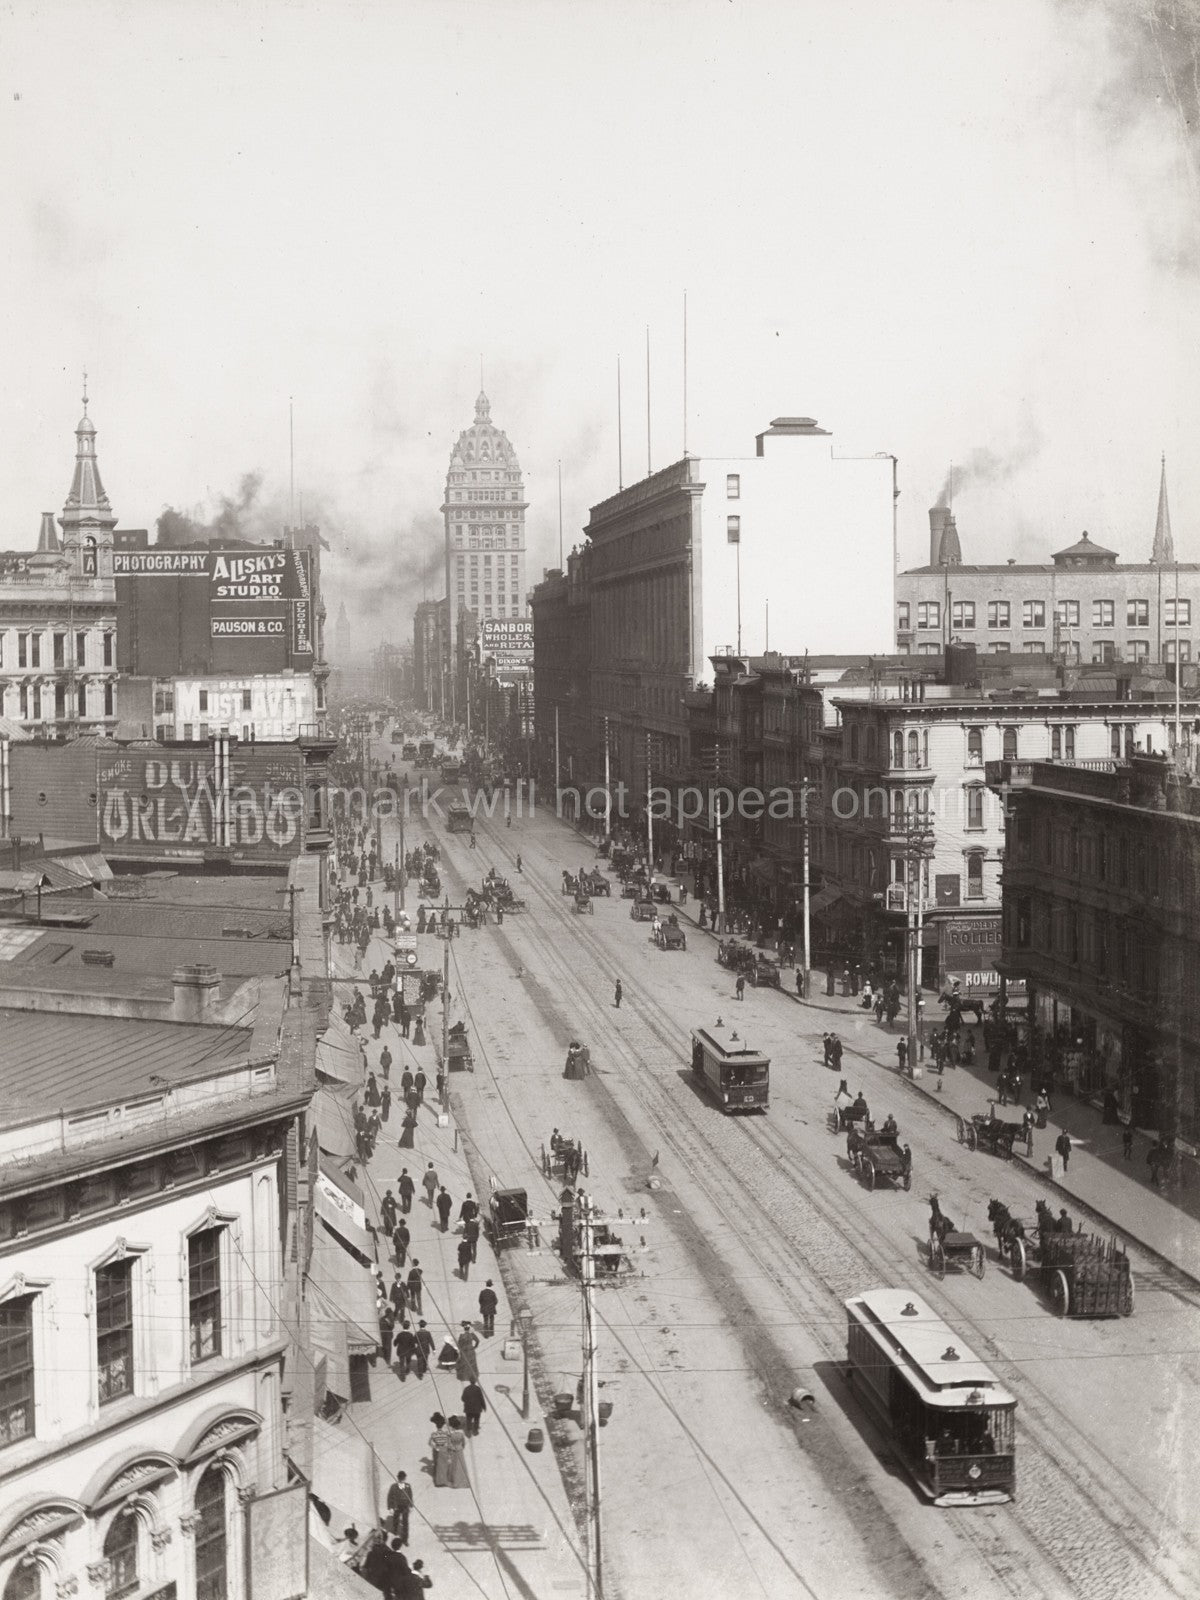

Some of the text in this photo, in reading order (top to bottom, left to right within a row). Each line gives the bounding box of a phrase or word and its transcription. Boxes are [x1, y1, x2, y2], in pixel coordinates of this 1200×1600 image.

[114, 555, 207, 571] PHOTOGRAPHY
[212, 553, 286, 582] ALISKY'S
[249, 574, 284, 584] ART
[217, 585, 283, 596] STUDIO.
[213, 621, 285, 633] PAUSON & CO.
[485, 633, 534, 641] WHOLES
